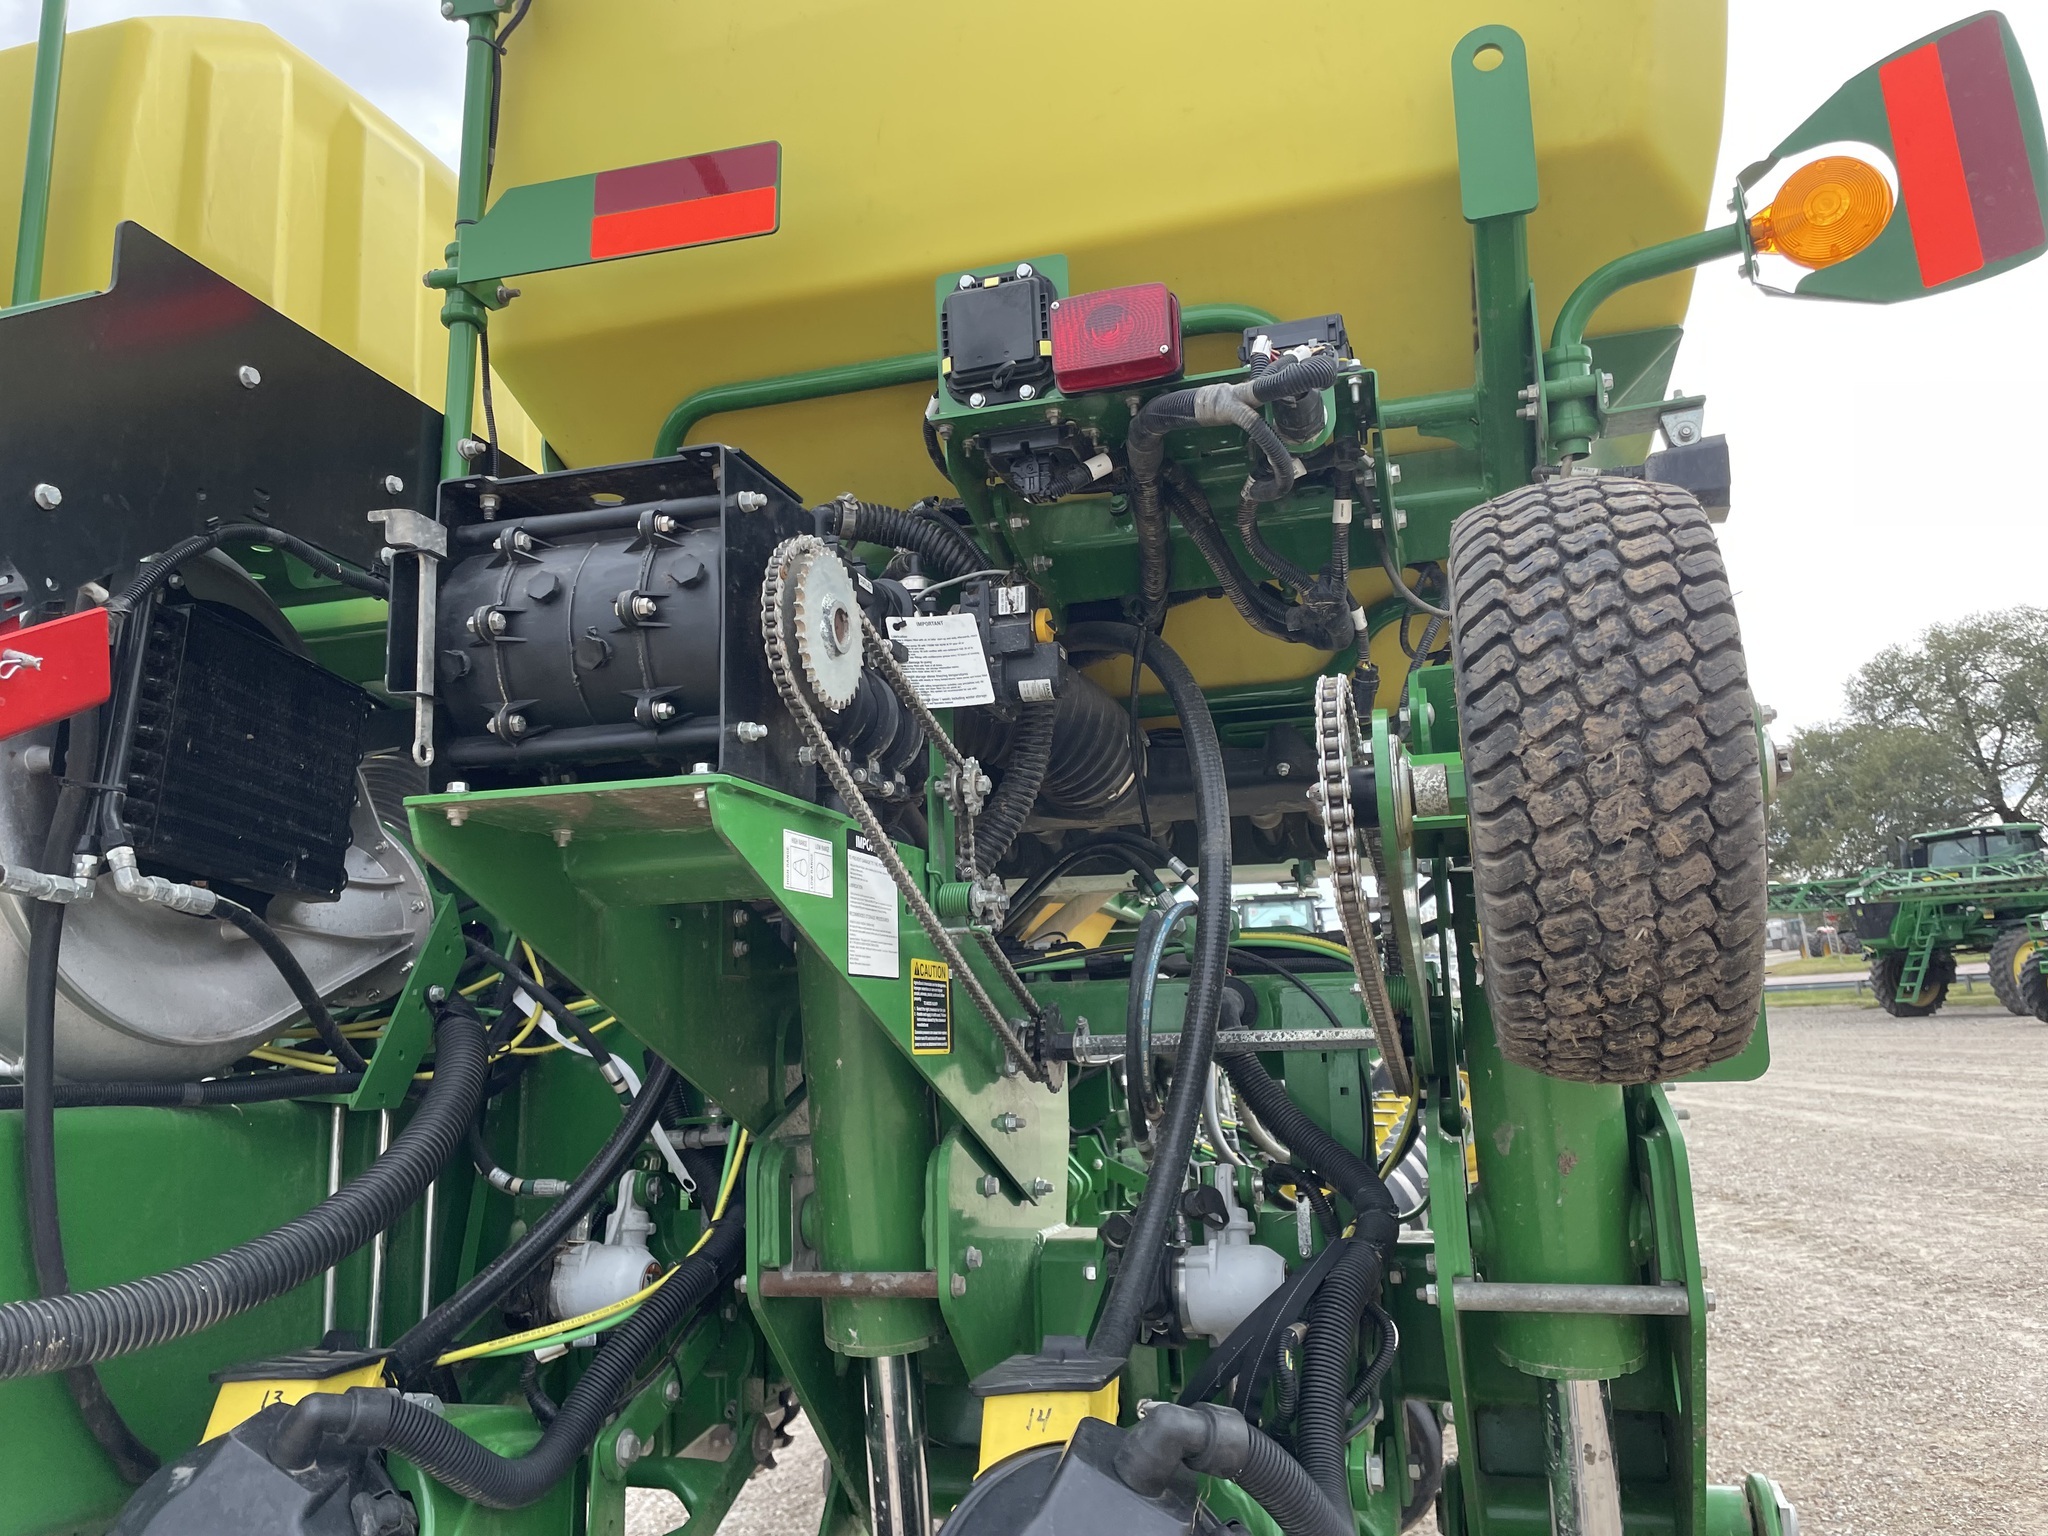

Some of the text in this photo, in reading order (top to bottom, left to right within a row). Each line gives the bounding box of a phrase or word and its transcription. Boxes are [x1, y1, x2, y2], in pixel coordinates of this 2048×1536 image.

[920, 963, 946, 979] CAUTION
[261, 1390, 284, 1410] 13
[1026, 1408, 1052, 1432] 14
